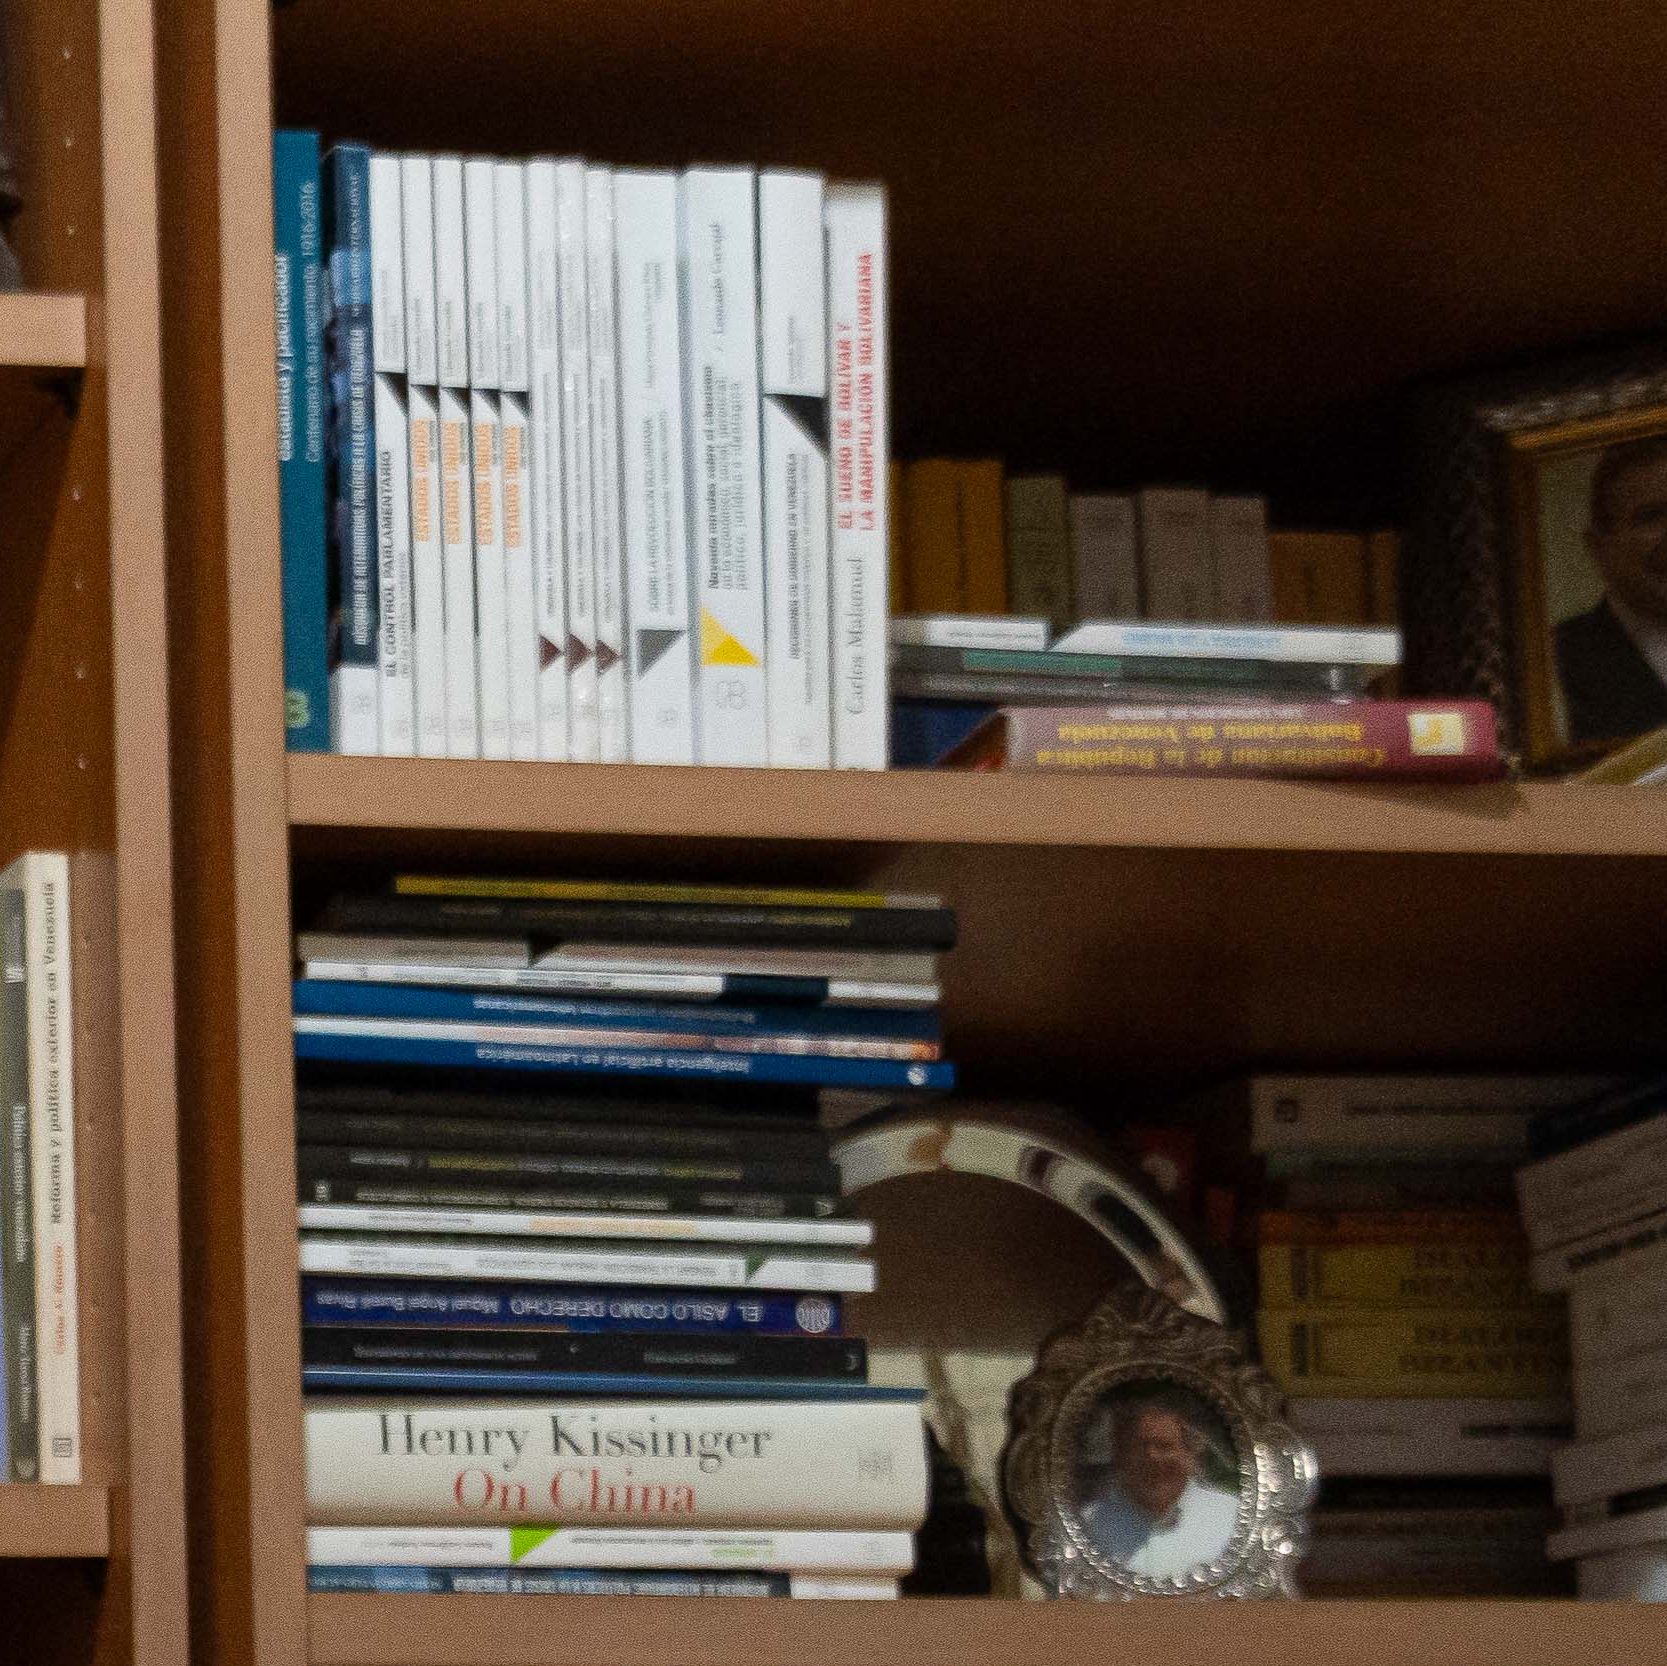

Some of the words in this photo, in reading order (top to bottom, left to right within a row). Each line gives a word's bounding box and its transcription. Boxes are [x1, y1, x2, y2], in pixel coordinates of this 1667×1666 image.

[858, 254, 873, 364] BOLIVARIANA
[836, 323, 851, 332] Y
[836, 419, 852, 439] DE
[380, 451, 394, 579] PARLAMENTARIO
[838, 511, 853, 529] EL
[860, 511, 874, 530] LA
[844, 557, 863, 647] Malamud
[384, 585, 395, 656] CONTROL
[846, 655, 864, 714] Carlos
[1057, 724, 1179, 743] Venezuela
[42, 882, 57, 965] Venezuela
[46, 972, 57, 992] en
[45, 998, 59, 1063] exterior
[667, 1054, 751, 1073] Inteligencia
[51, 1138, 62, 1148] y
[48, 1153, 63, 1224] Reforma
[510, 1299, 605, 1319] DERECHO
[610, 1302, 668, 1320] COMO
[673, 1303, 729, 1322] ASILO
[735, 1304, 760, 1323] EL
[379, 1413, 529, 1473] Henry
[550, 1413, 772, 1476] Kissinger
[452, 1468, 529, 1514] On
[549, 1465, 697, 1515] China
